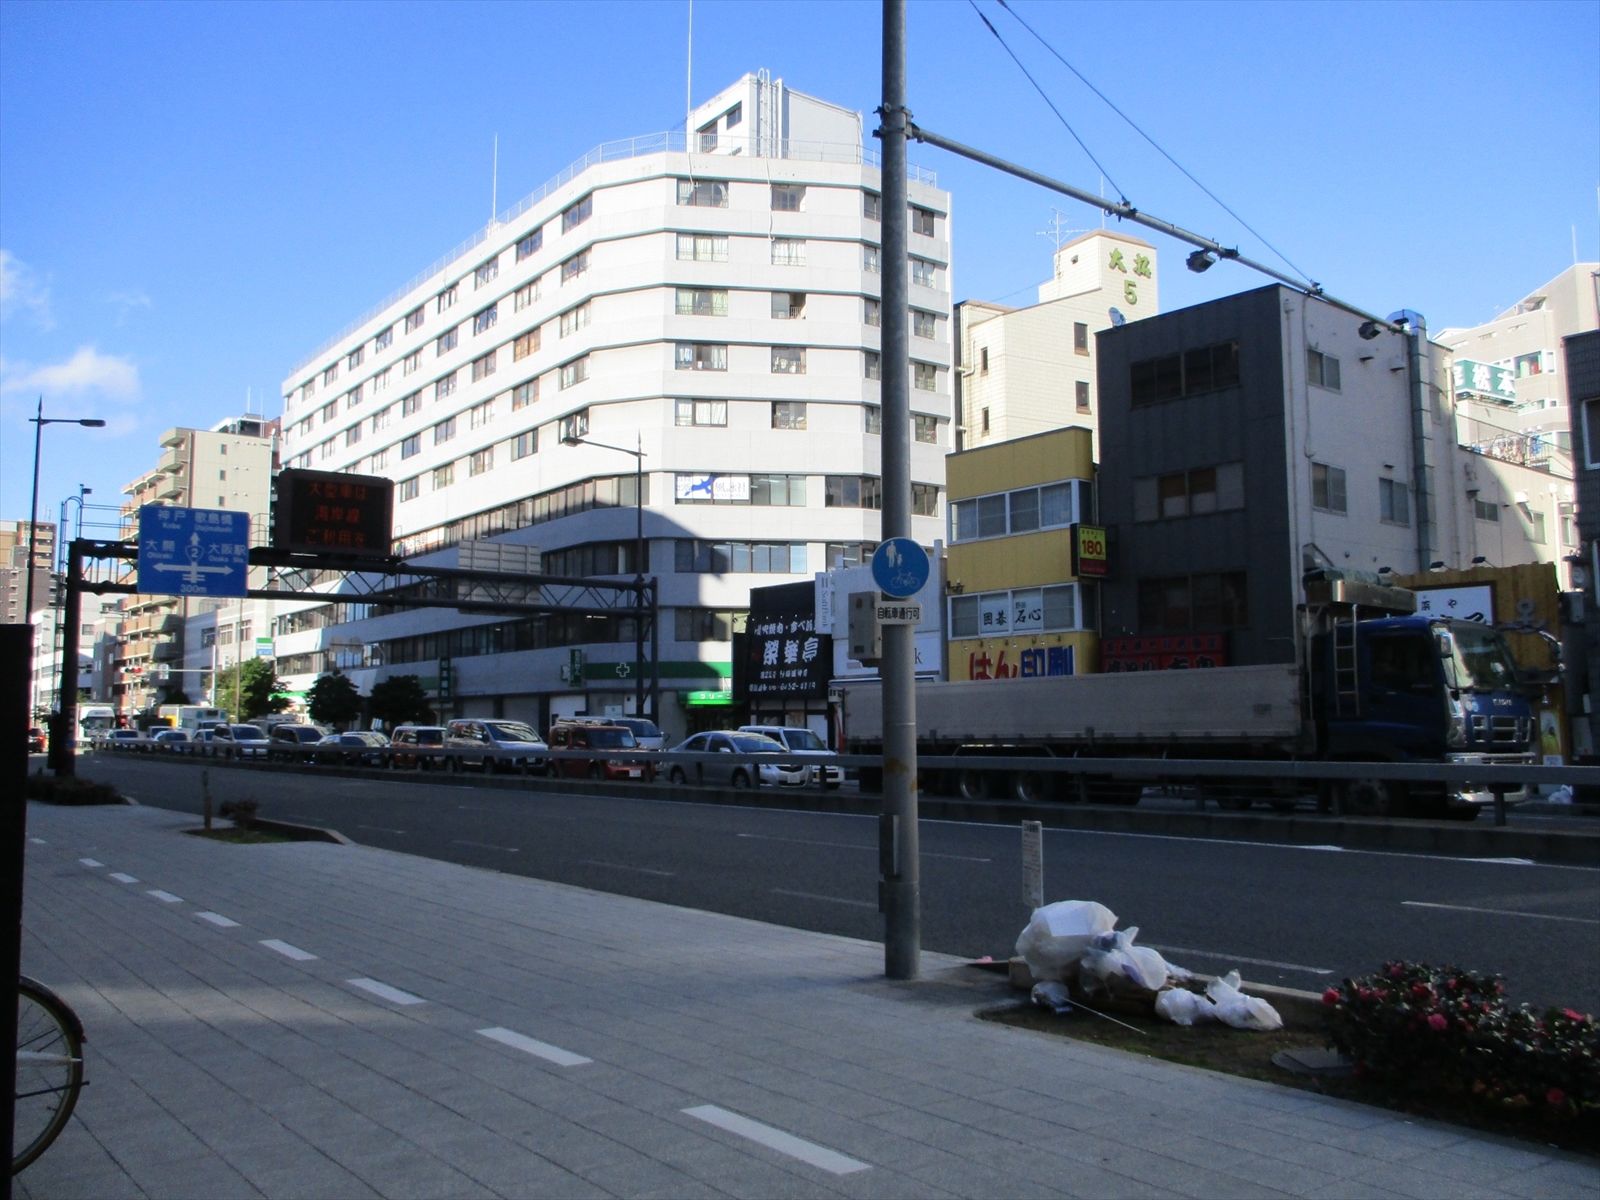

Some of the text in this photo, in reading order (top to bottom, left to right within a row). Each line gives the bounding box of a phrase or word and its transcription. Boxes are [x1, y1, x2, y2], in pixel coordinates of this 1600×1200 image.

[1123, 279, 1138, 305] 5
[191, 548, 199, 558] 2
[208, 542, 247, 557] 大阪駅
[1081, 539, 1103, 555] 180
[180, 582, 207, 594] 300m
[877, 606, 920, 620] 自転車通行可
